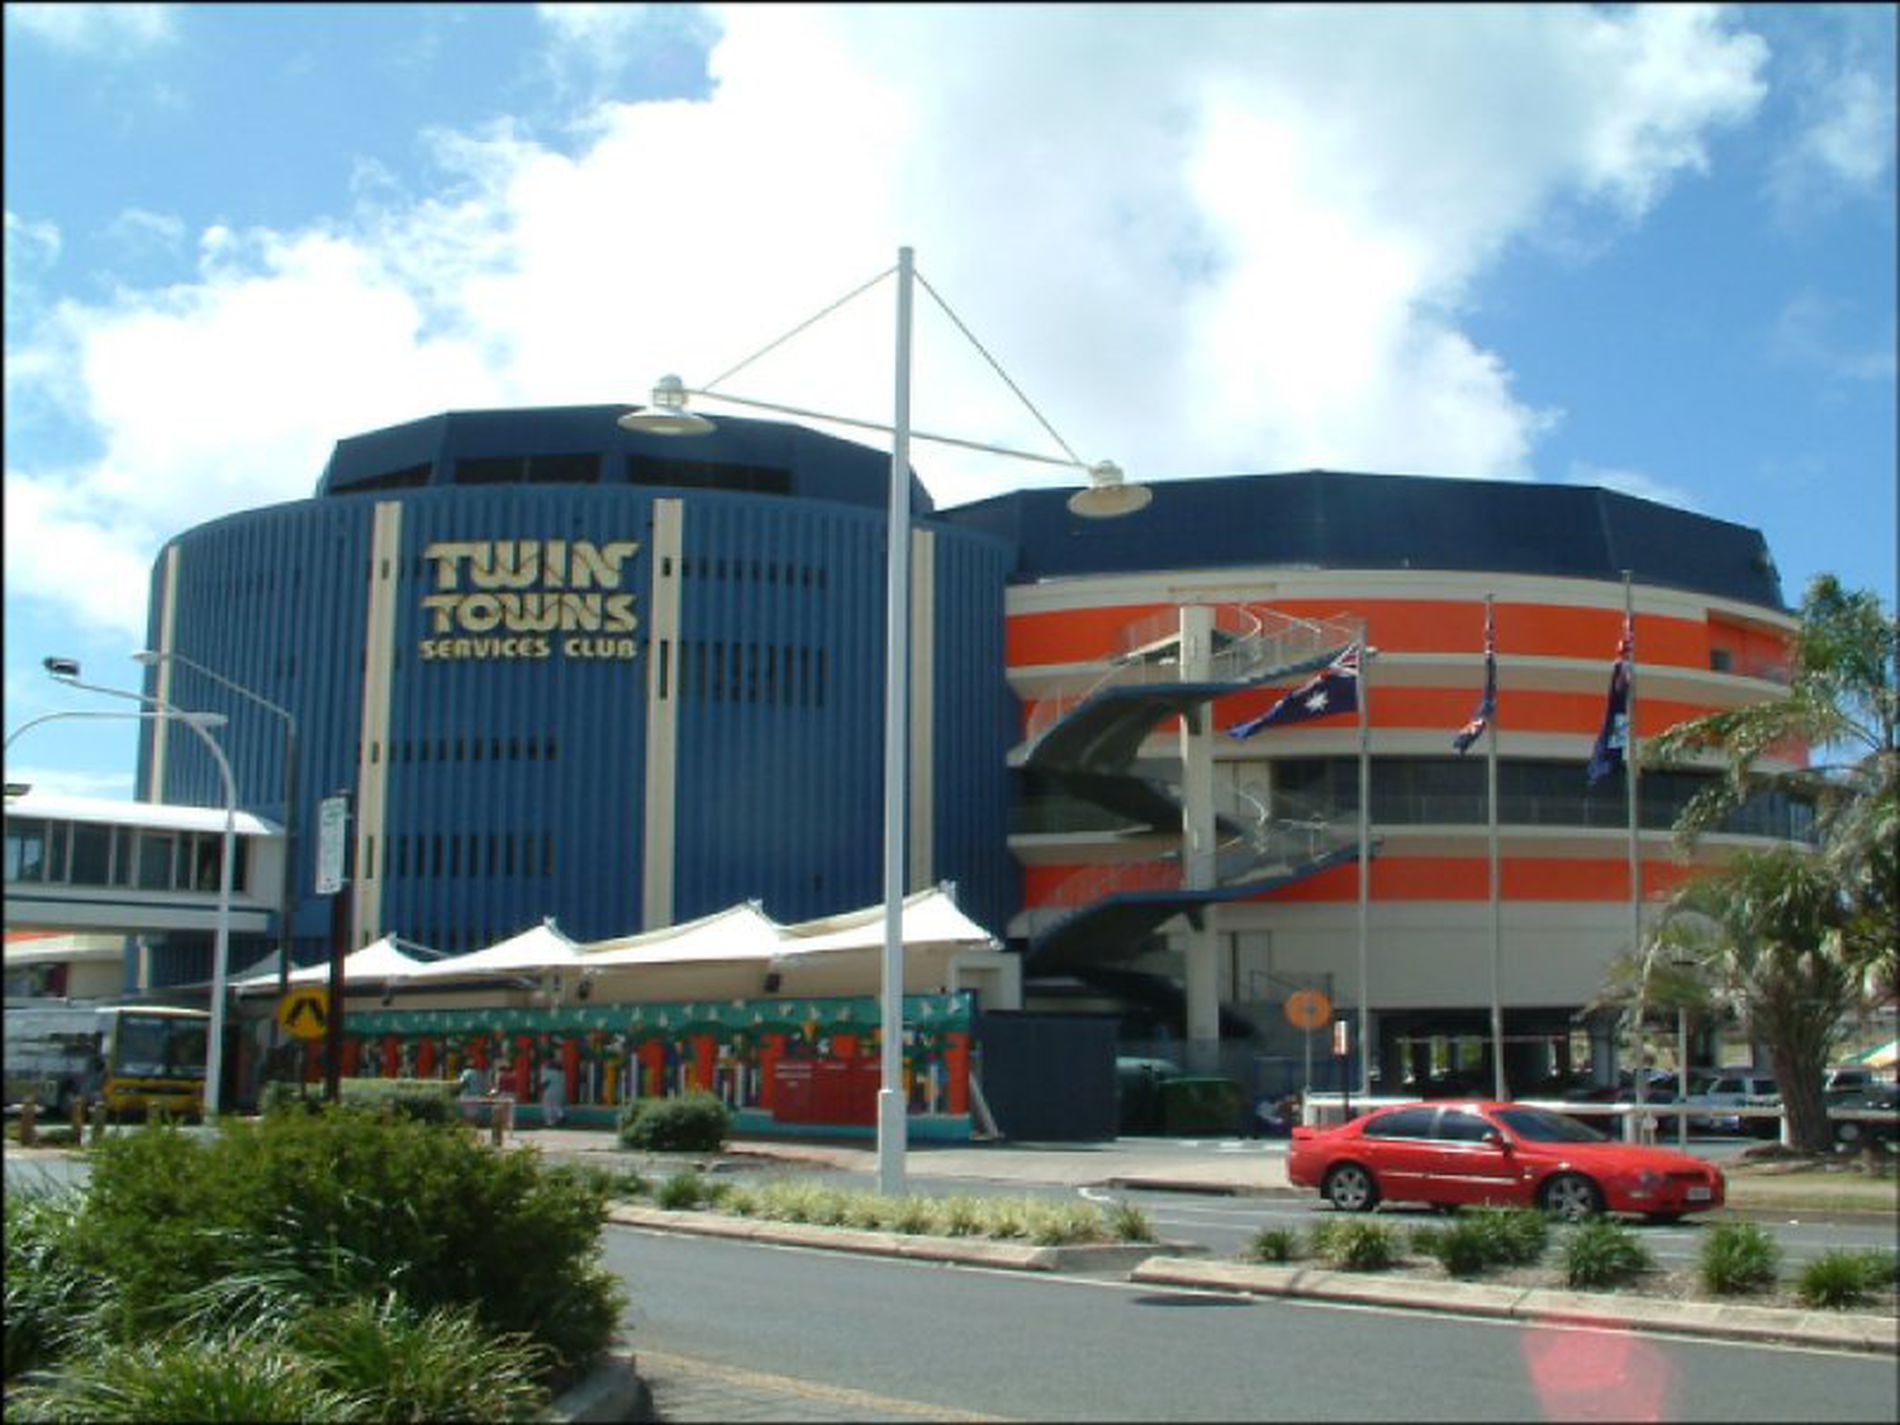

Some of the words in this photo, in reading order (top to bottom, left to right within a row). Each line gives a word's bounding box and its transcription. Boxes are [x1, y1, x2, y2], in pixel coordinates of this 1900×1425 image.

[423, 541, 641, 590] TWIN
[420, 592, 637, 632] TOWNS
[420, 639, 551, 660] SERVICES
[564, 638, 638, 659] CLUB
